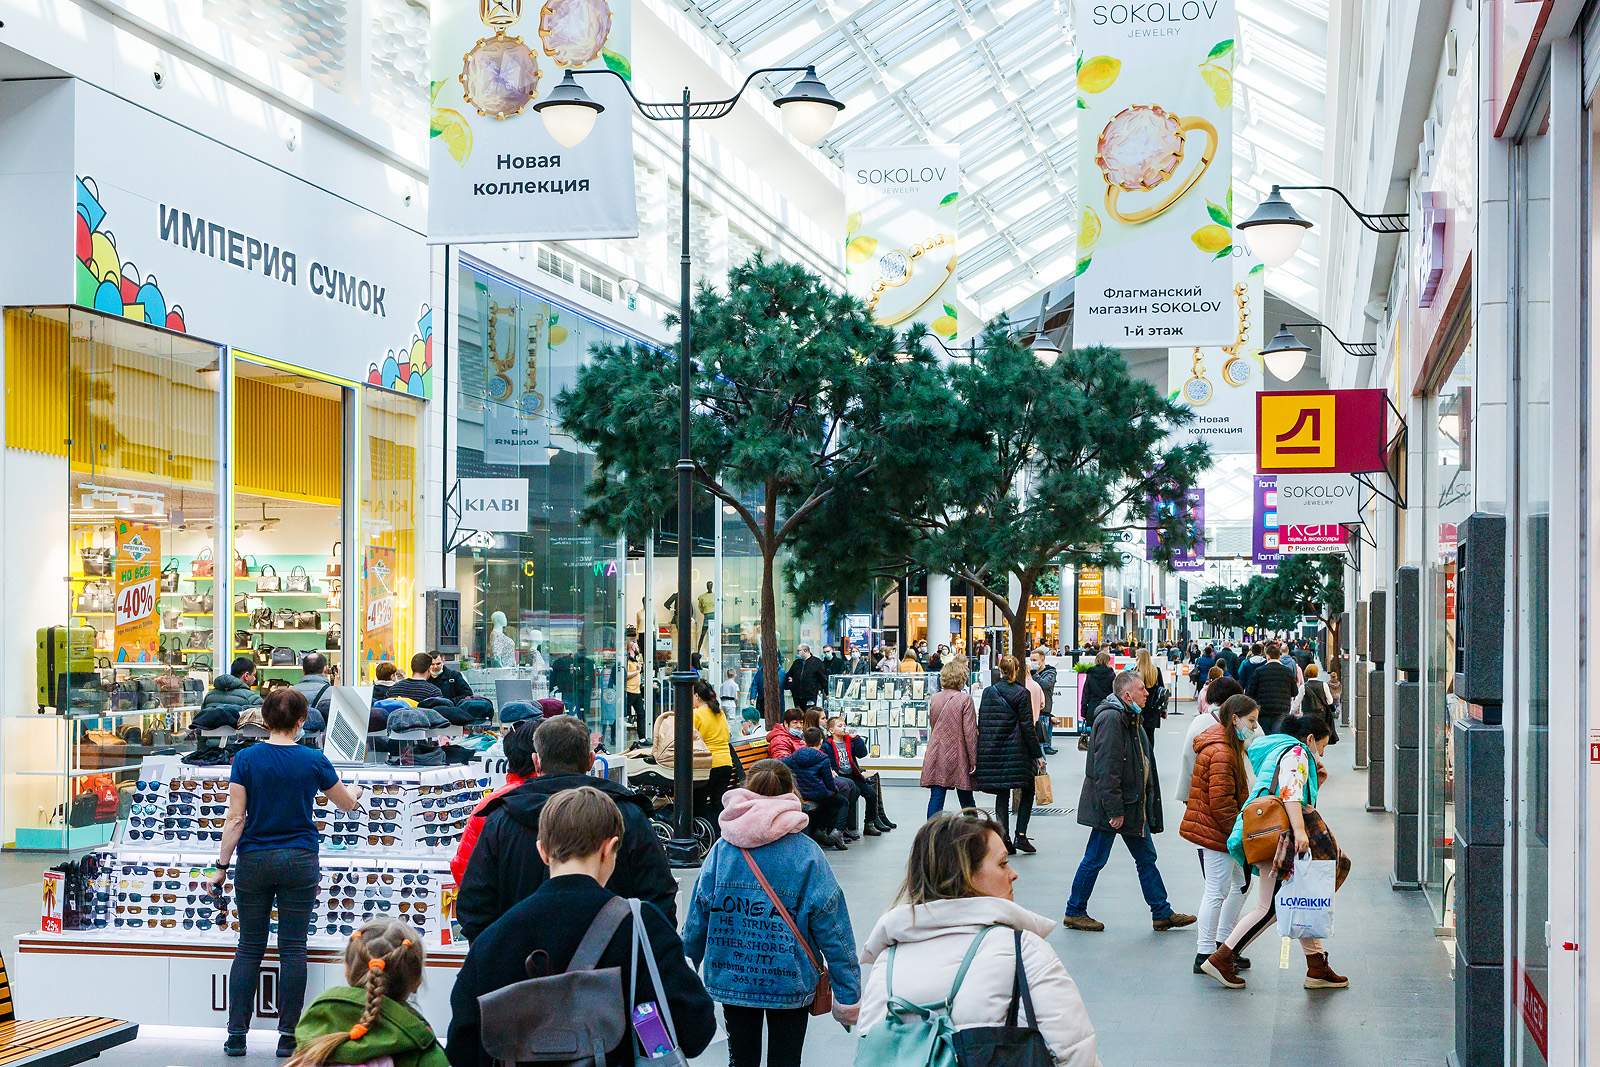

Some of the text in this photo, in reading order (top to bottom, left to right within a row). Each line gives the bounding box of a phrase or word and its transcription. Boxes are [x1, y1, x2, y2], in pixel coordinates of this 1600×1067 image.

[1092, 0, 1218, 26] SOKOLOV
[1127, 27, 1182, 39] JEWELRY
[496, 154, 562, 170] Новая
[856, 167, 947, 185] SOKOLOV
[473, 178, 590, 196] коллекция
[159, 203, 388, 318] ИМПЕРИЯ СУМОК
[1103, 285, 1202, 299] Флагманский
[1088, 301, 1222, 315] магазин SOKOLOV
[1123, 325, 1184, 336] 1-й этаж
[1199, 415, 1230, 424] Новая
[1188, 426, 1243, 436] коллекция
[1283, 485, 1355, 498] SOKOLOV
[465, 498, 519, 511] KIABI
[117, 583, 154, 620] -40%
[45, 919, 59, 932] -25%
[720, 916, 734, 926] HE
